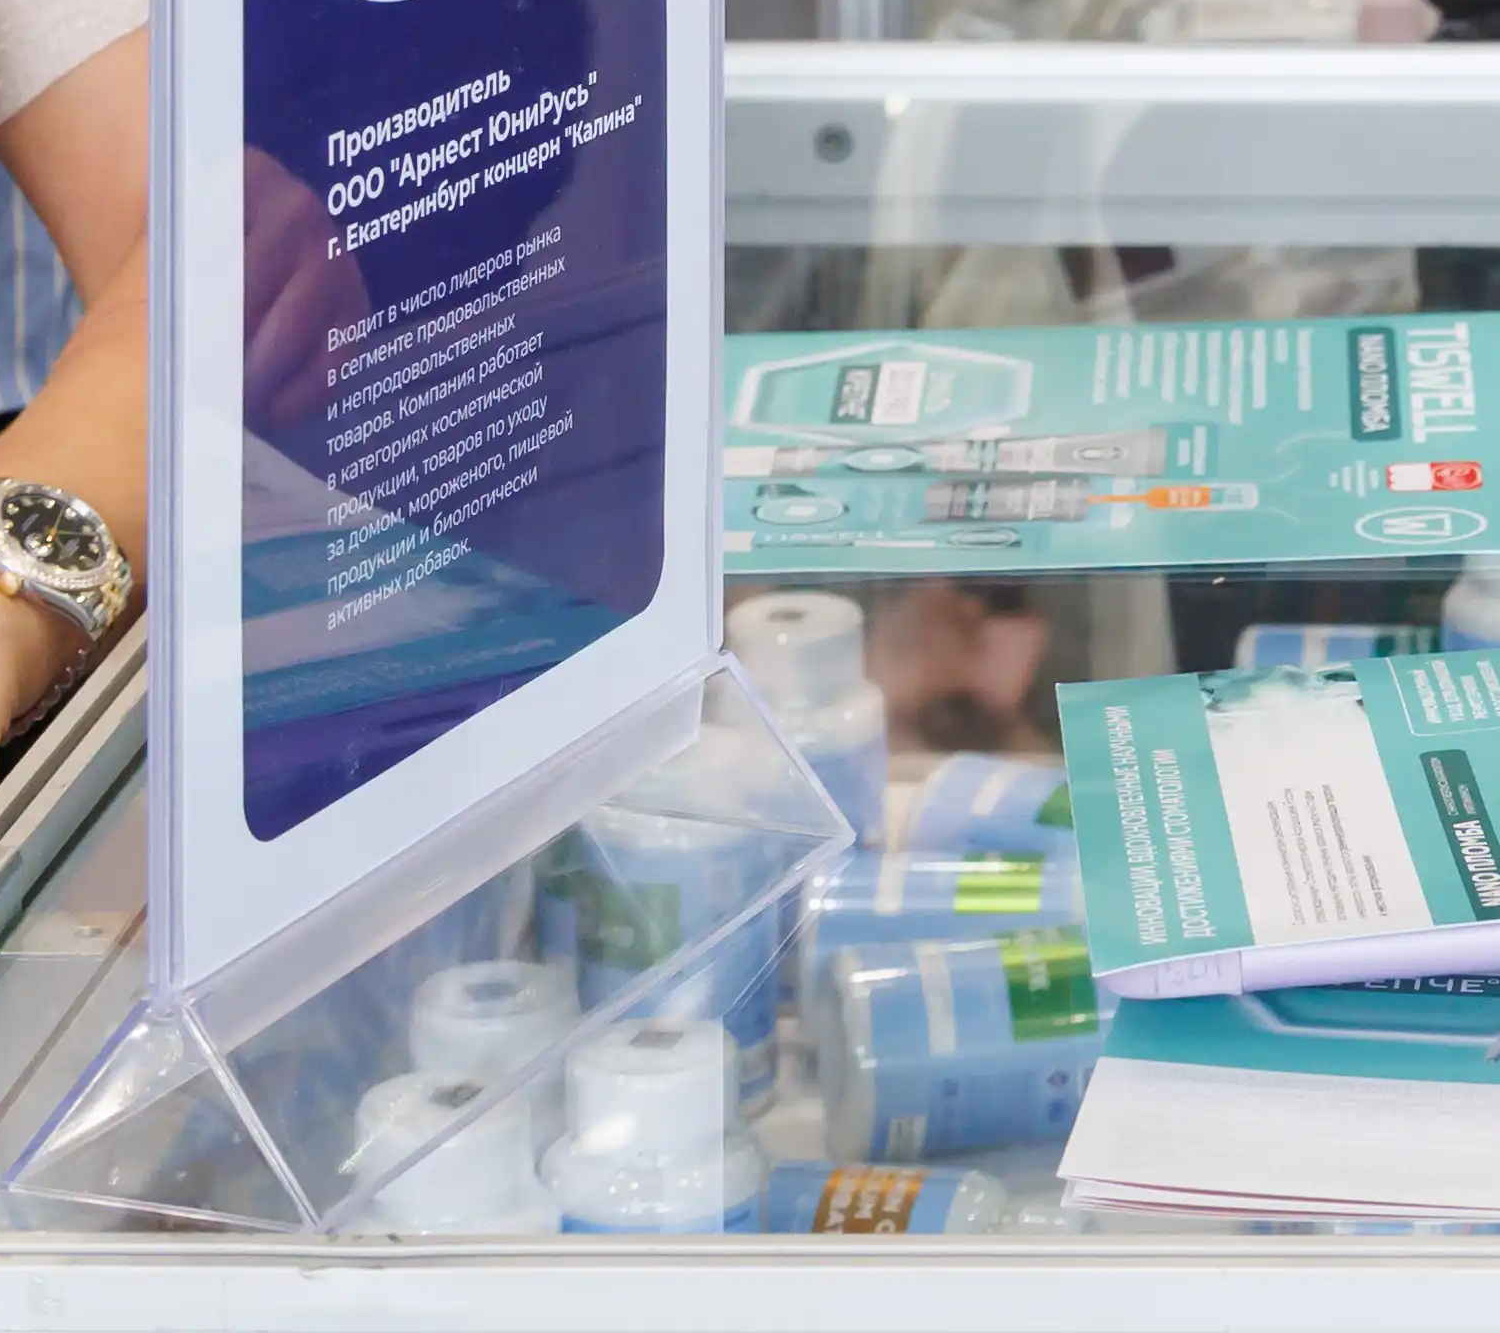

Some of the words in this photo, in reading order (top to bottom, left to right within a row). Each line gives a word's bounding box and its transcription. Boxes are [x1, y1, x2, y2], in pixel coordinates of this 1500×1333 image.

[327, 69, 511, 167] Производитель
[327, 166, 384, 217] ООО
[390, 127, 484, 188] "Арнест
[488, 70, 599, 146] ЮниРусь"
[327, 236, 342, 261] г.
[346, 173, 480, 253] Екатеринбург
[483, 135, 561, 189] концерн
[564, 94, 643, 148] "Калина"
[327, 309, 384, 353] Входит
[388, 304, 398, 324] в
[400, 281, 447, 315] число
[449, 248, 513, 296] лидеров
[516, 225, 562, 261] рынка
[327, 368, 337, 388] в
[340, 330, 414, 381] сегменте
[416, 255, 566, 343] продовольственных
[327, 403, 338, 422] и
[342, 312, 516, 413] непродовольственных
[327, 412, 395, 455] товаров.
[398, 369, 476, 421] Компания
[478, 331, 544, 381] работает
[327, 472, 337, 492] в
[340, 425, 429, 487] категориях
[431, 362, 544, 433] косметической
[1406, 321, 1479, 443] TISWELL
[327, 465, 420, 527] продукции,
[422, 434, 483, 476] товаров
[486, 419, 505, 441] по
[507, 394, 548, 436] уходу
[327, 542, 345, 562] за
[348, 507, 405, 552] домом,
[408, 454, 506, 517] мороженого,
[508, 409, 574, 463] пищевой
[327, 533, 416, 596] продукции
[419, 526, 430, 545] и
[433, 465, 539, 537] биологически
[327, 578, 402, 631] активных
[405, 537, 472, 590] добавок.
[1104, 705, 1137, 766] НАУЧНЫМИ
[1152, 749, 1192, 835] СТОМАТОЛОГИИ
[1113, 765, 1157, 863] ВДОХНОВЛЕННЫЕ
[1453, 819, 1498, 873] ПЛОМБА
[1129, 863, 1168, 945] ИННОВАЦИИ,
[1167, 837, 1217, 938] ДОСТИЖЕНИЯМИ
